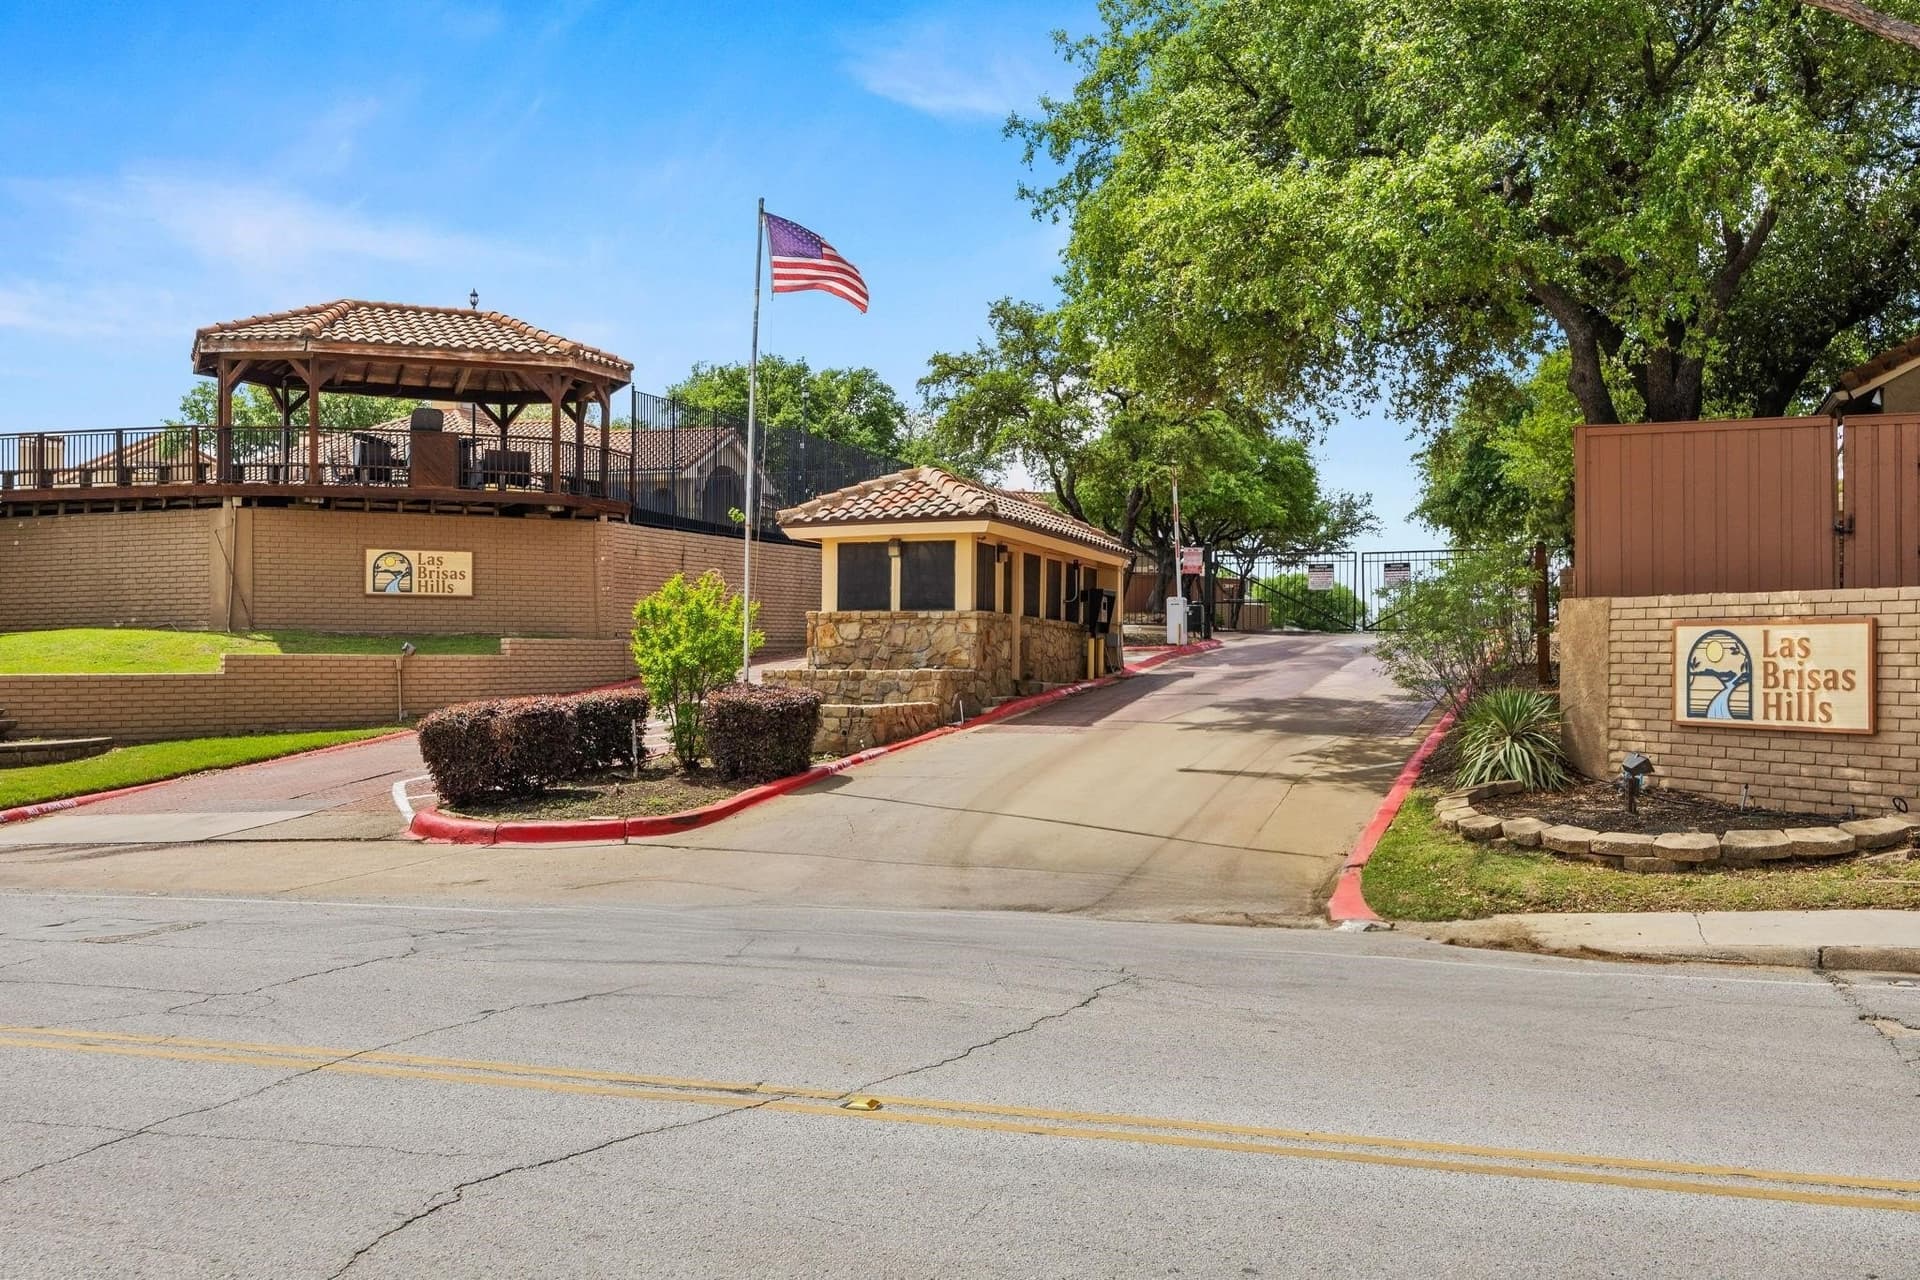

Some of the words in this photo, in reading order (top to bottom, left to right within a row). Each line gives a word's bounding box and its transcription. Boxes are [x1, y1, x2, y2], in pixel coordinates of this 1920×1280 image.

[417, 552, 444, 567] Las
[417, 566, 466, 580] Brisas
[417, 579, 455, 594] Hills
[1762, 629, 1811, 659] Las
[1762, 660, 1856, 692] Brisas
[1762, 691, 1833, 723] Hills
